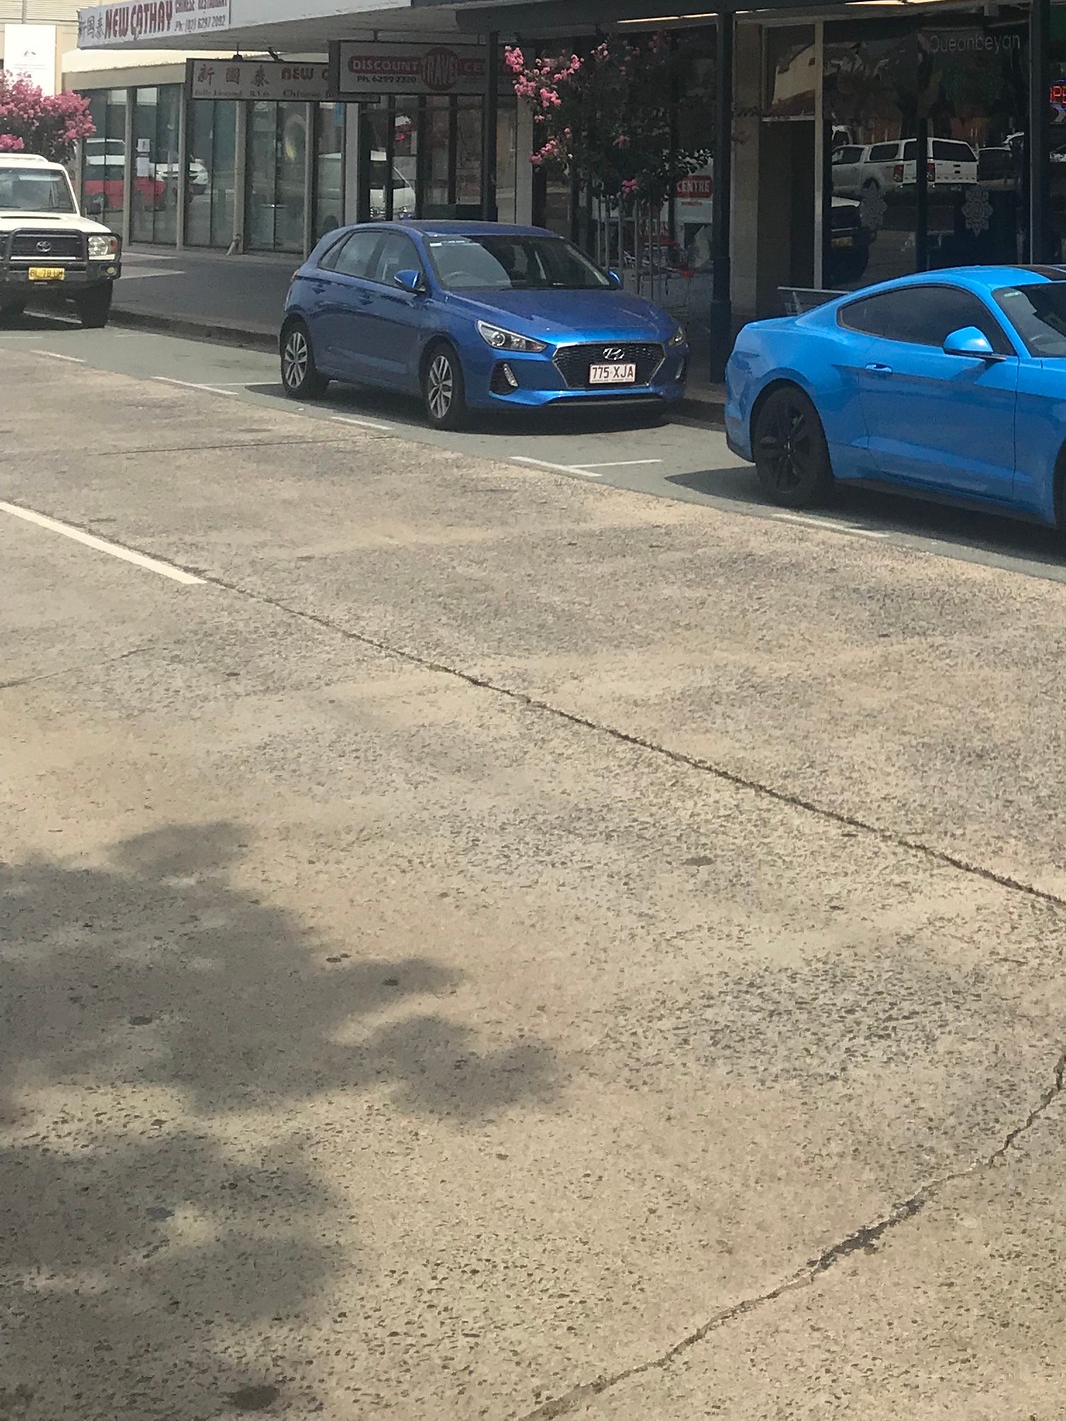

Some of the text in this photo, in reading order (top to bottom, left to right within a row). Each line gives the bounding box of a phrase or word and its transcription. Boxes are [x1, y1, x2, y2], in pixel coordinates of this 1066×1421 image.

[104, 0, 174, 40] NEW CATHAY
[352, 58, 418, 71] DISCOUNT
[676, 179, 711, 193] CENTRE
[592, 365, 634, 379] 775 XJA
